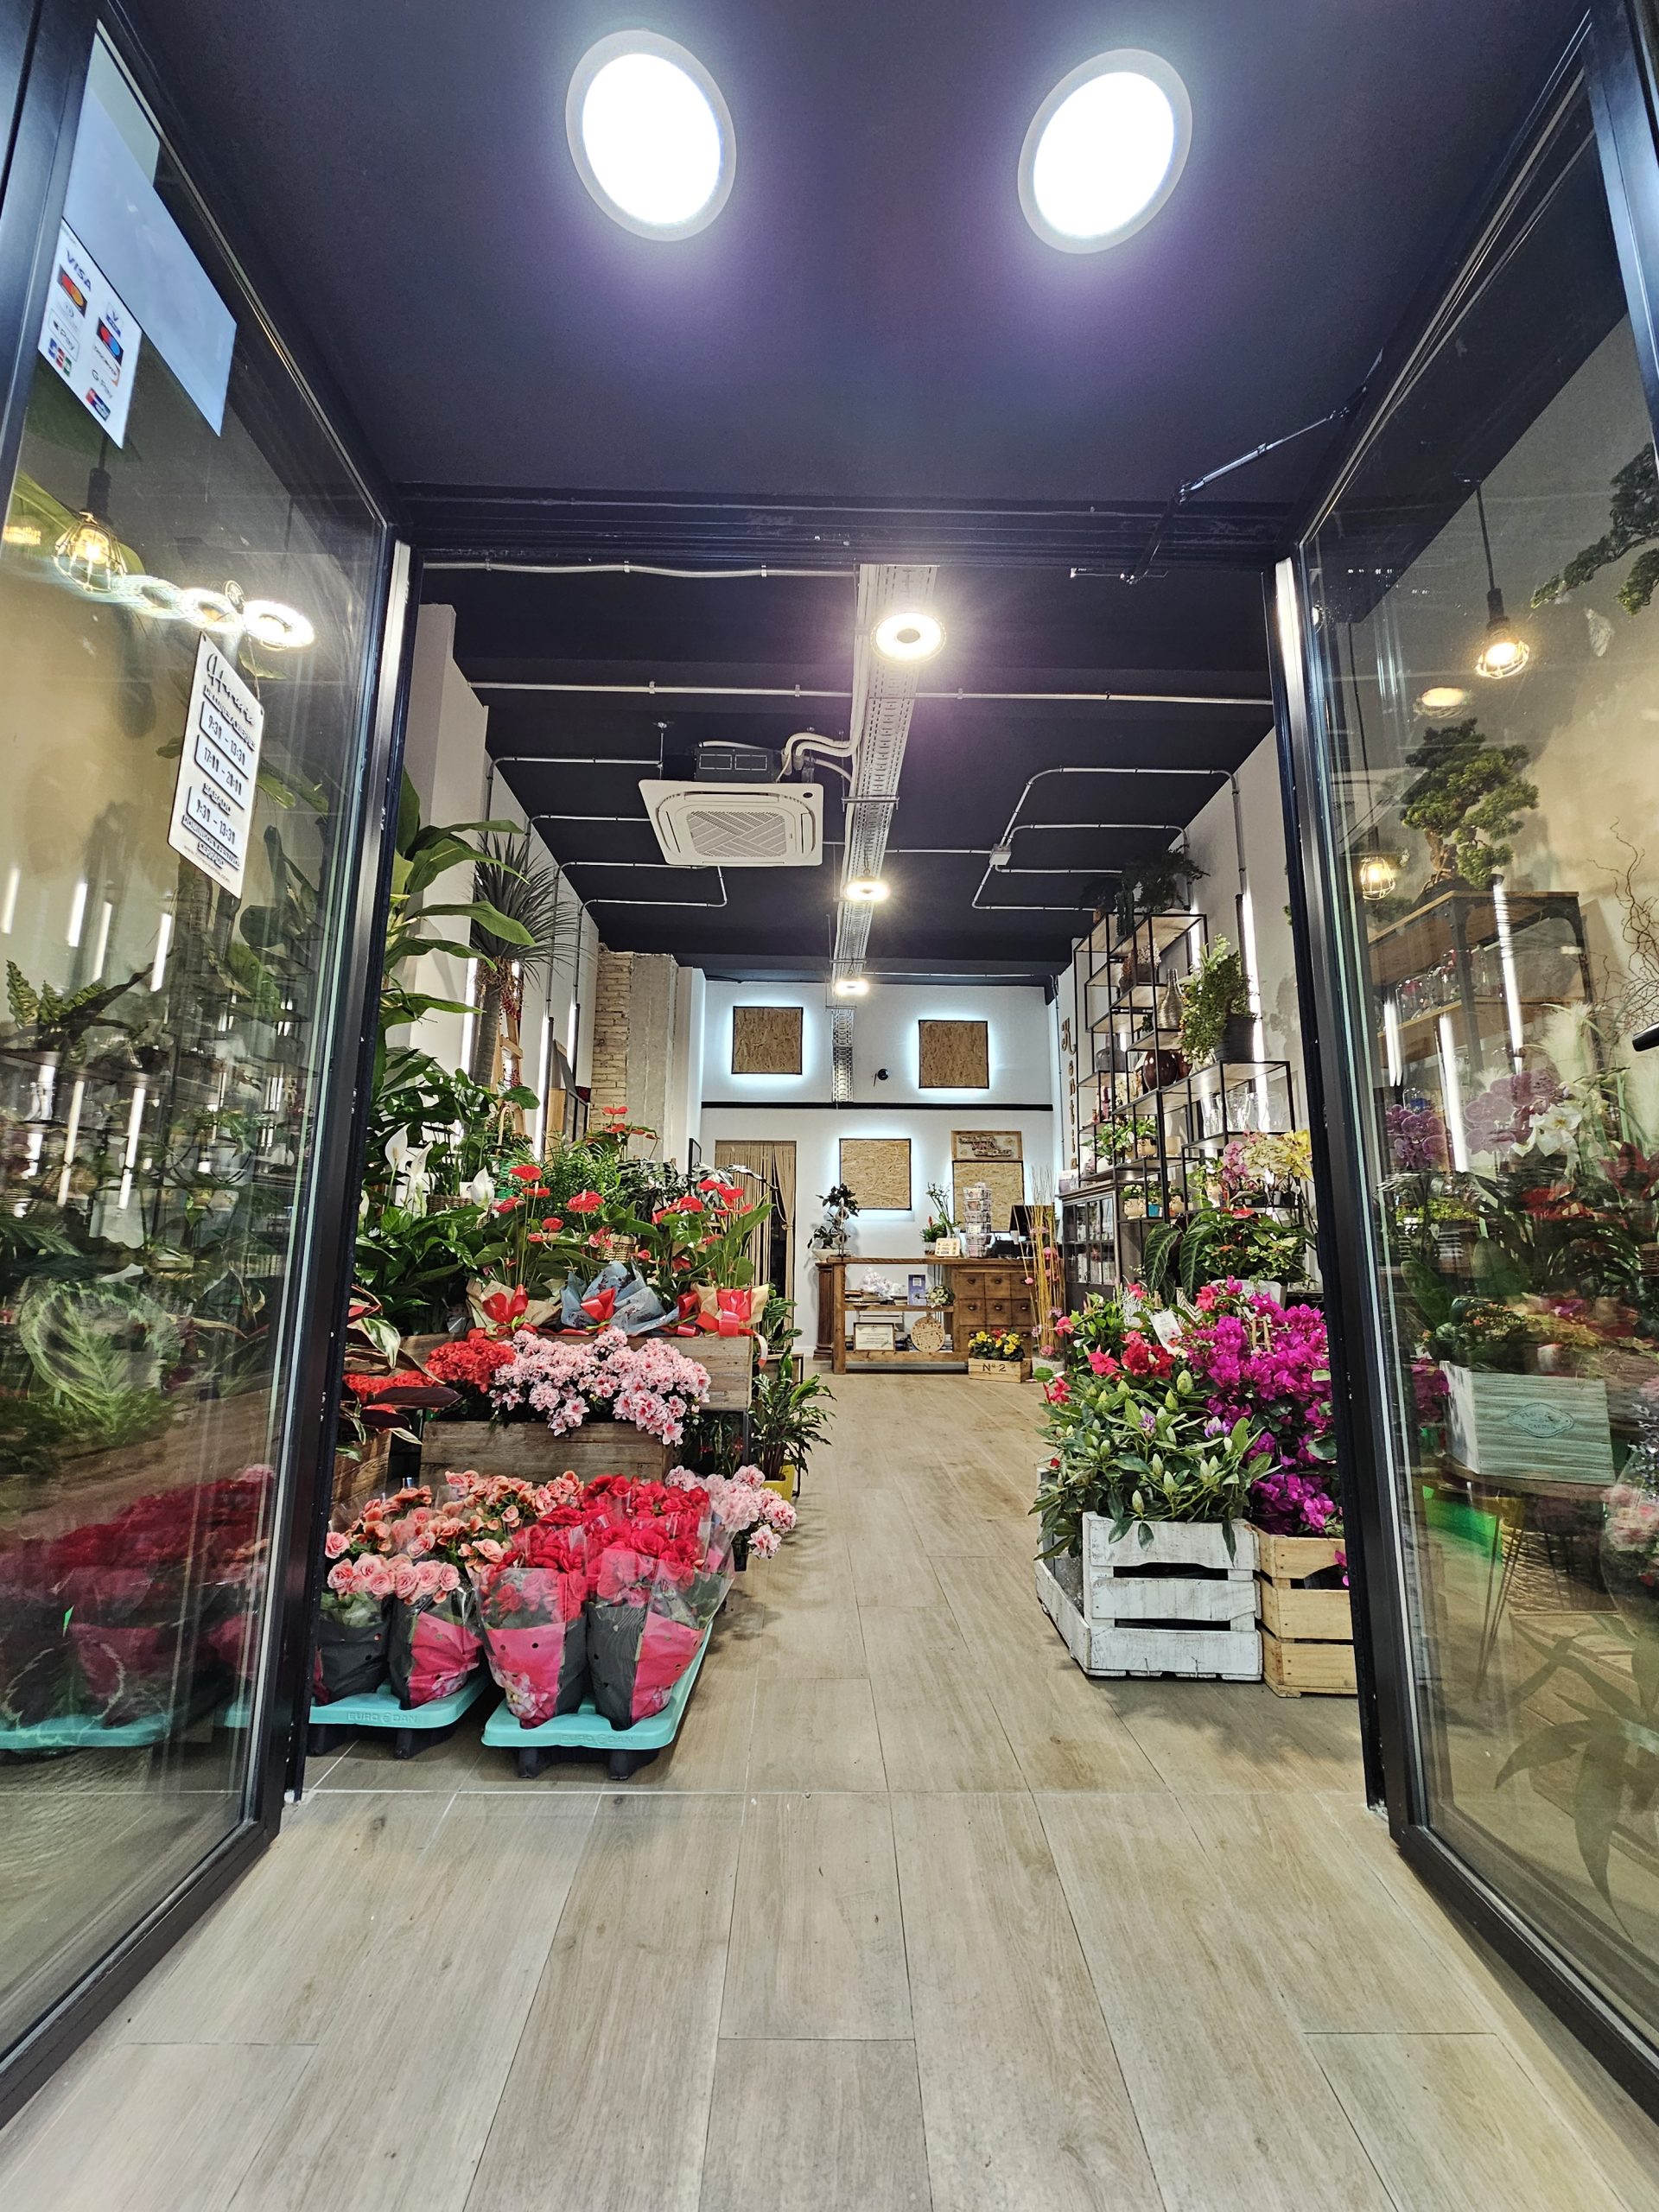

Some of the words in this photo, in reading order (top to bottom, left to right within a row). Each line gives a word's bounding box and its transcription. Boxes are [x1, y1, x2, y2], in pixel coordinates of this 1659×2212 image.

[67, 250, 92, 292] VISA
[60, 328, 75, 351] Pay
[100, 379, 114, 398] Pay
[231, 740, 246, 766] 13:30
[219, 820, 236, 845] 13:30
[999, 1363, 1007, 1372] 2
[347, 1712, 379, 1722] EURO
[560, 1733, 594, 1743] EURO
